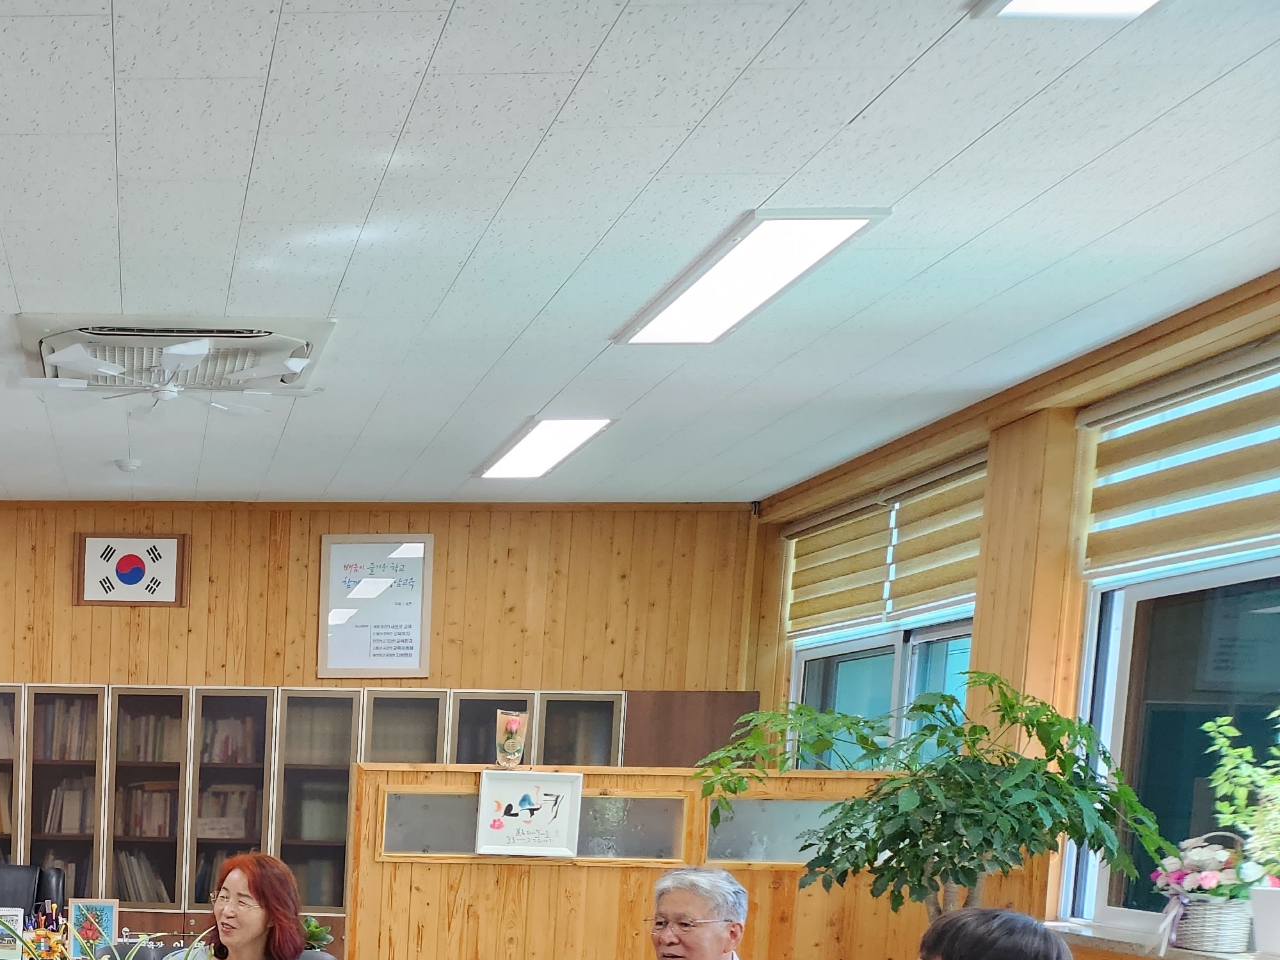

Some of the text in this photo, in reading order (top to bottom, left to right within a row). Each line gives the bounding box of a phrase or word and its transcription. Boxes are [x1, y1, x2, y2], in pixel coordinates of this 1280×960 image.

[343, 562, 406, 576] 배움이 즐거운 학교
